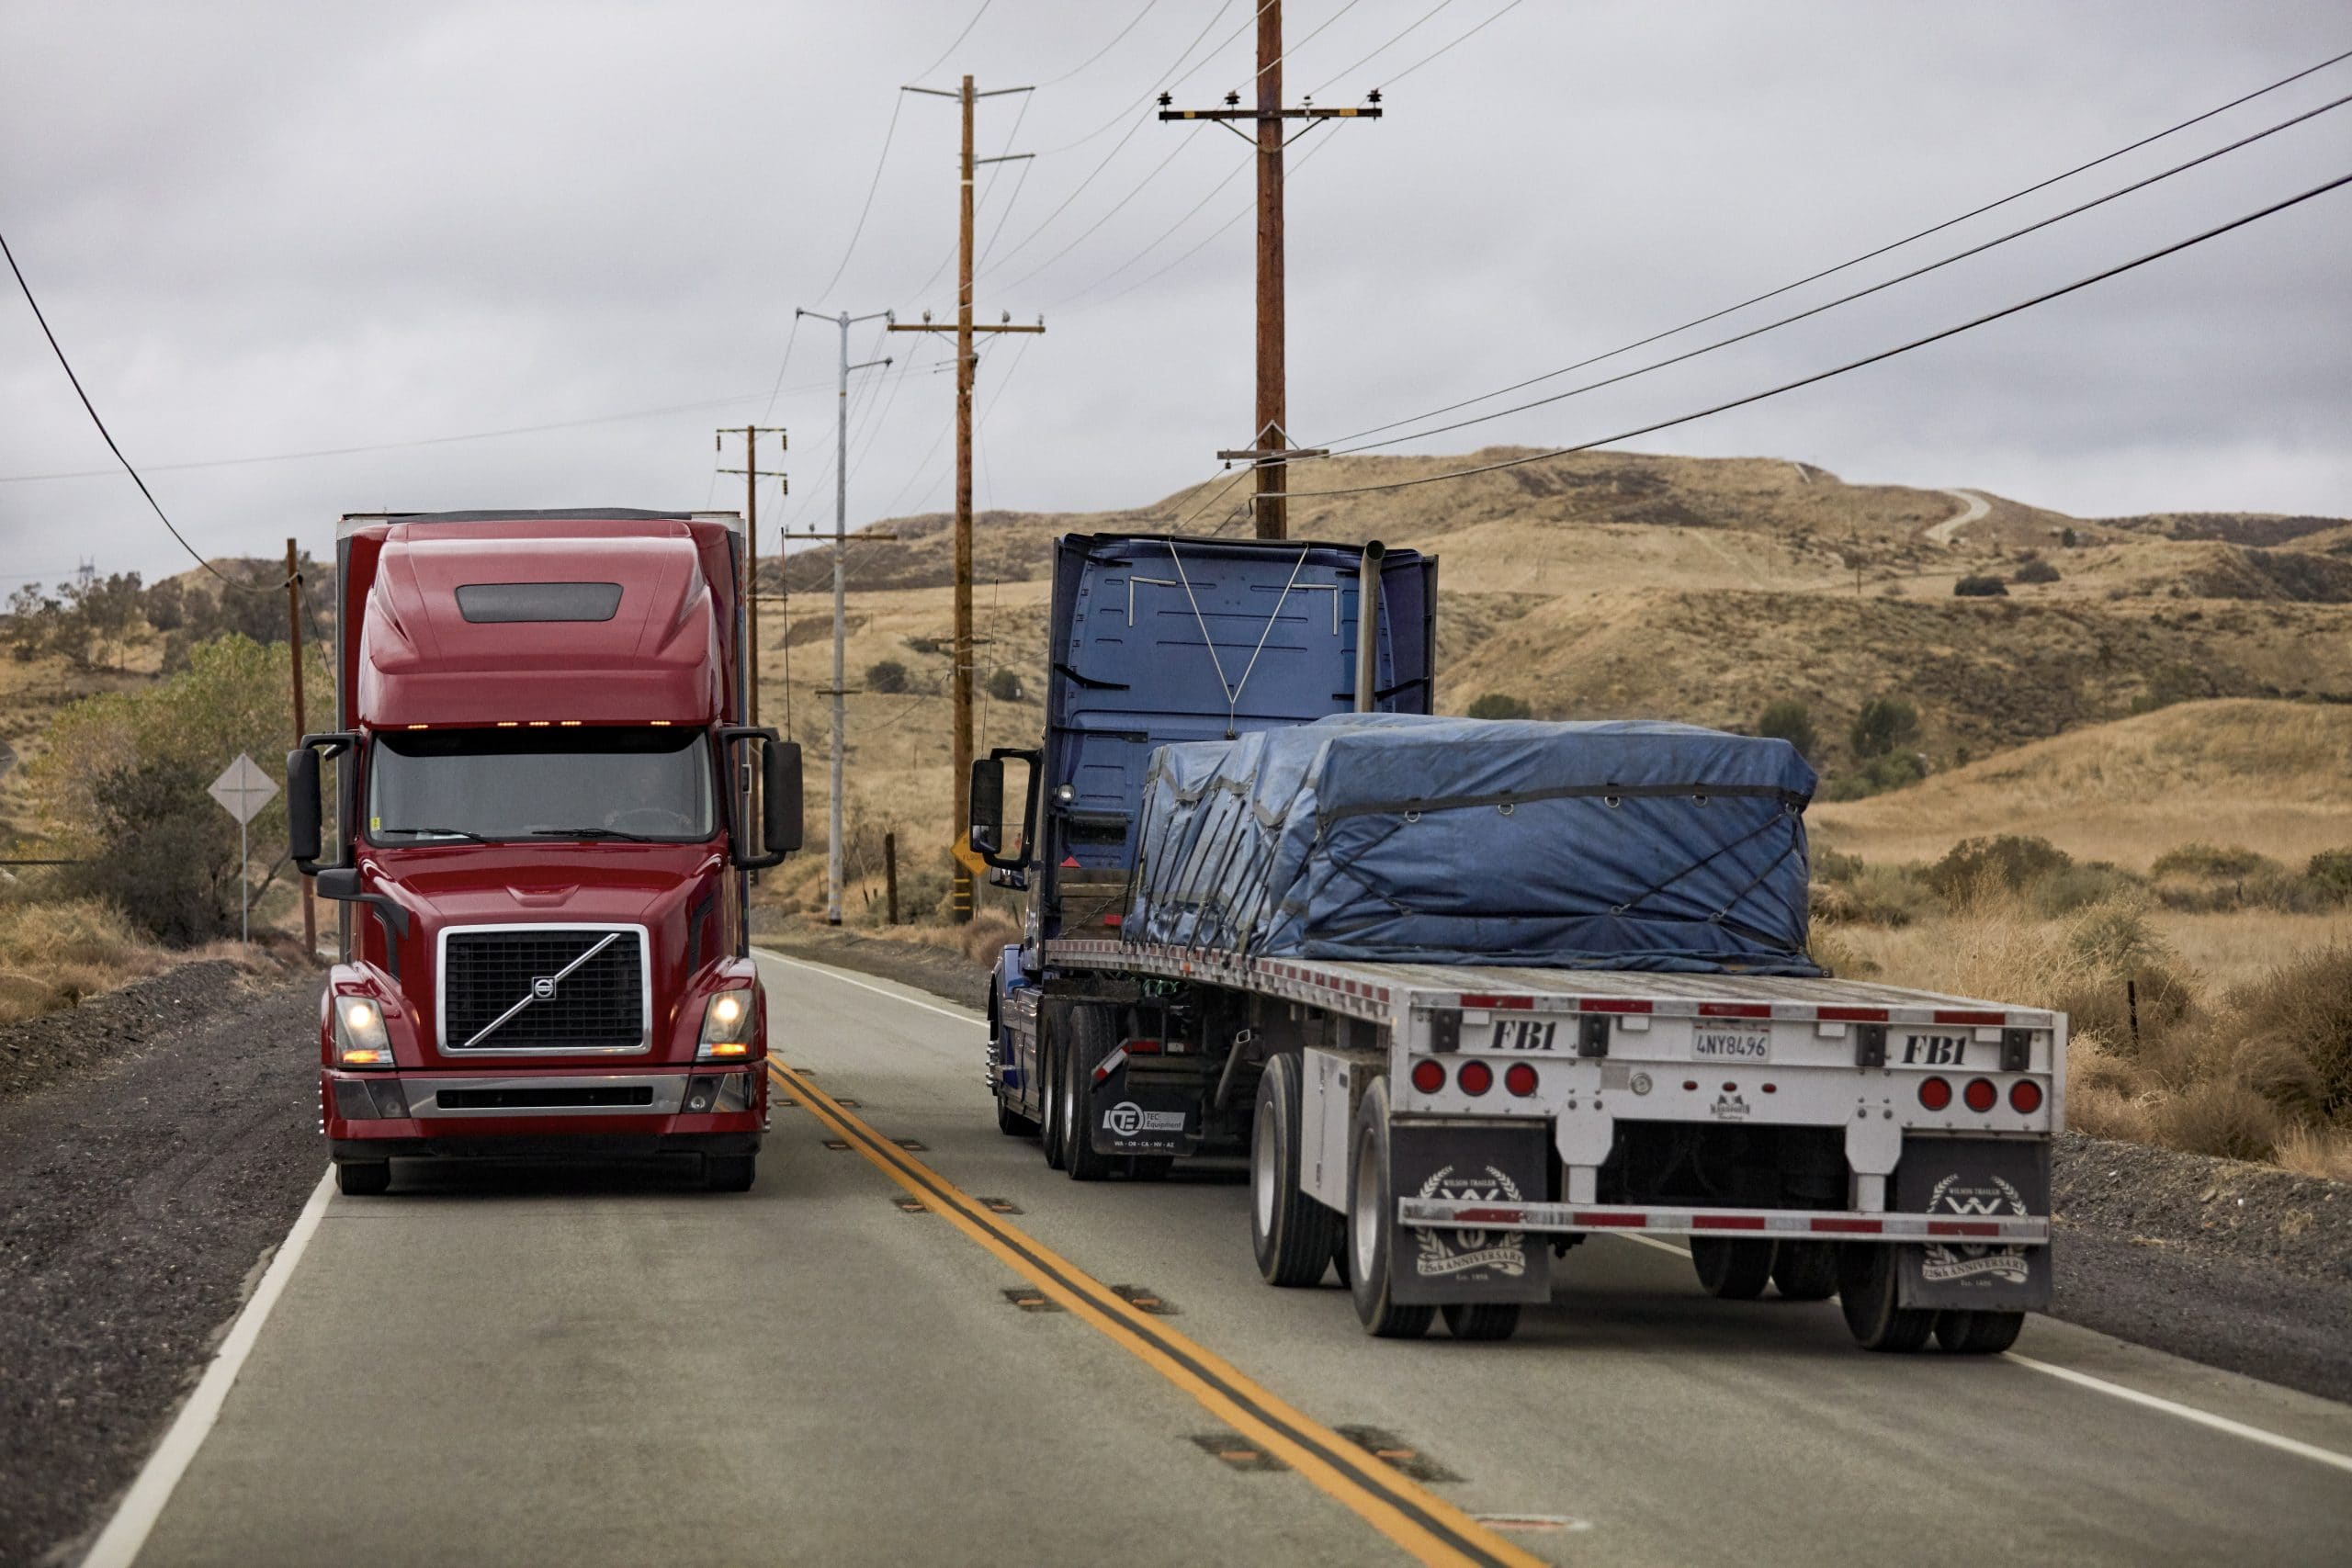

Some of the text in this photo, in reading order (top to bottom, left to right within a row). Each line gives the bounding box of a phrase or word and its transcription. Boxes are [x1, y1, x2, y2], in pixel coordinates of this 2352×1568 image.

[1696, 1034, 1766, 1056] 4NY8496
[1147, 1112, 1160, 1121] TEC
[1147, 1121, 1182, 1129] Equipment
[1442, 1179, 1497, 1187] WILSON TRAILER
[1446, 1250, 1522, 1269] ANNIVERSARY
[1950, 1258, 2025, 1278] ANNIVERSARY
